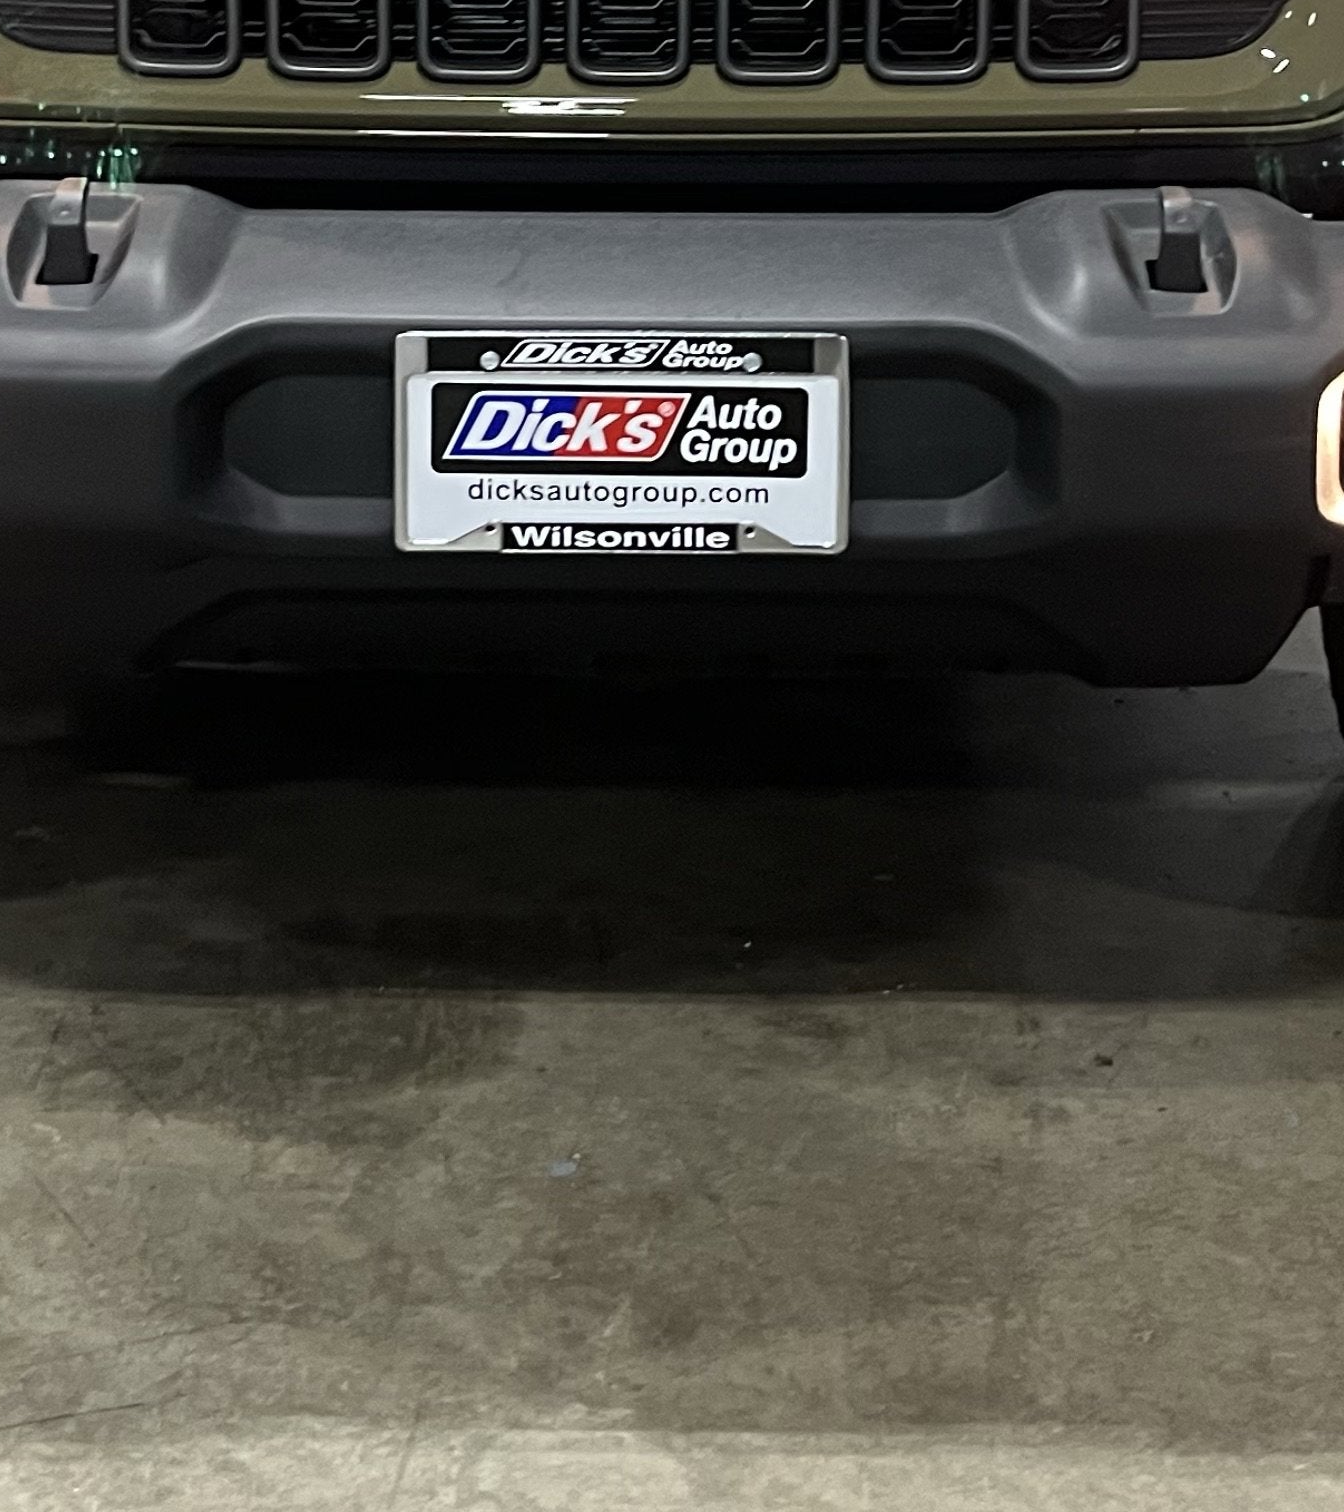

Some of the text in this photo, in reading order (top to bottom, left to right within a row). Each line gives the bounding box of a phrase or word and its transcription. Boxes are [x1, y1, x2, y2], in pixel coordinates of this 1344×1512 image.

[512, 340, 733, 364] Dick's Auto
[662, 353, 744, 370] Group
[460, 395, 783, 453] Dick's Auto
[680, 429, 798, 471] Group
[467, 479, 769, 507] dicksautogroup.com
[511, 526, 731, 549] Wilsonville
